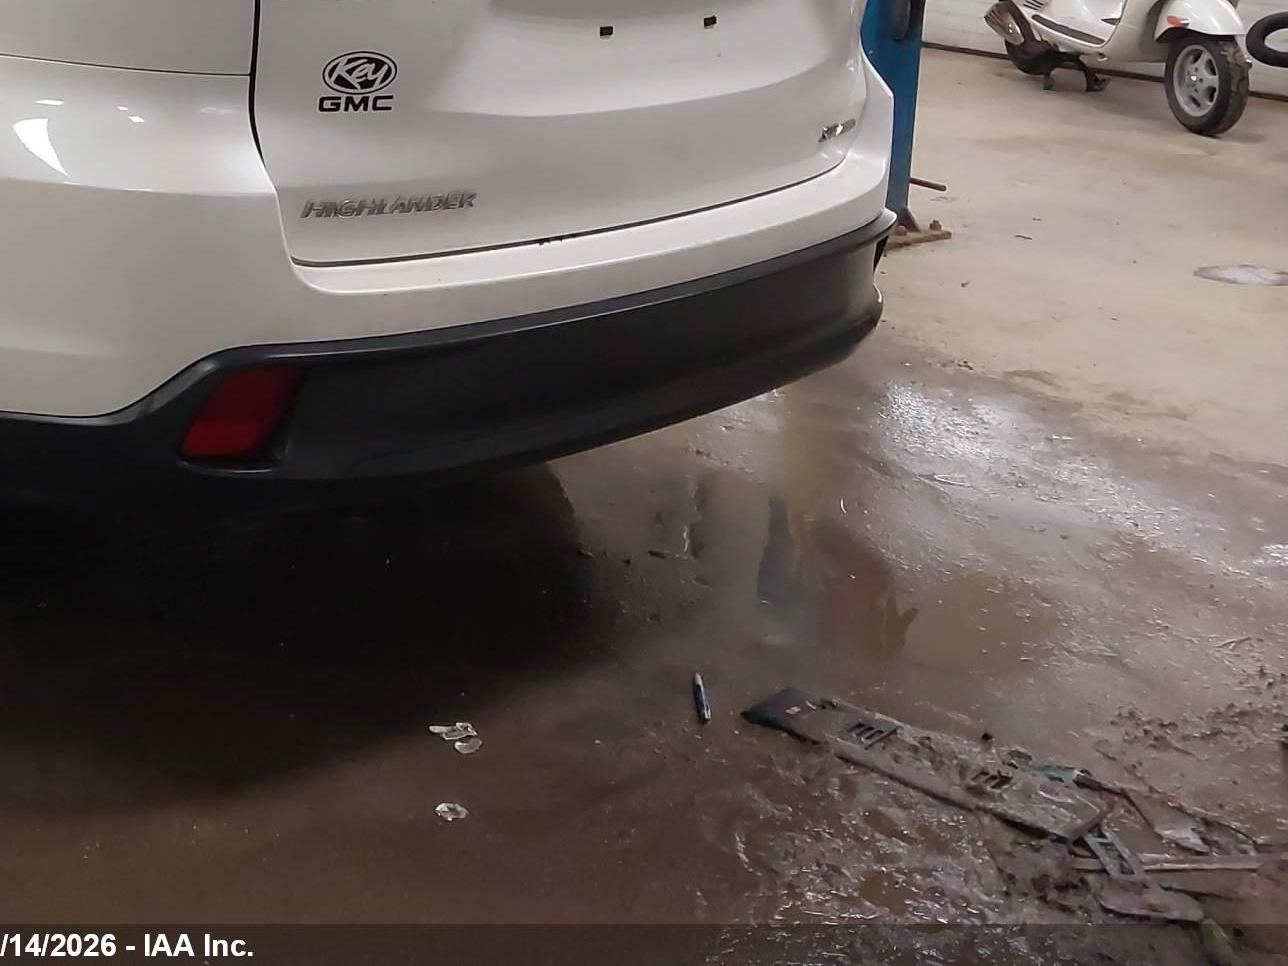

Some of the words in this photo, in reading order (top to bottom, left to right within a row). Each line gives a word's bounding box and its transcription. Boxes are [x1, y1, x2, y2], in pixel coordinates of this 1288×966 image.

[328, 57, 389, 91] Key
[318, 95, 394, 113] GMC
[300, 192, 478, 219] HIGHLANDER
